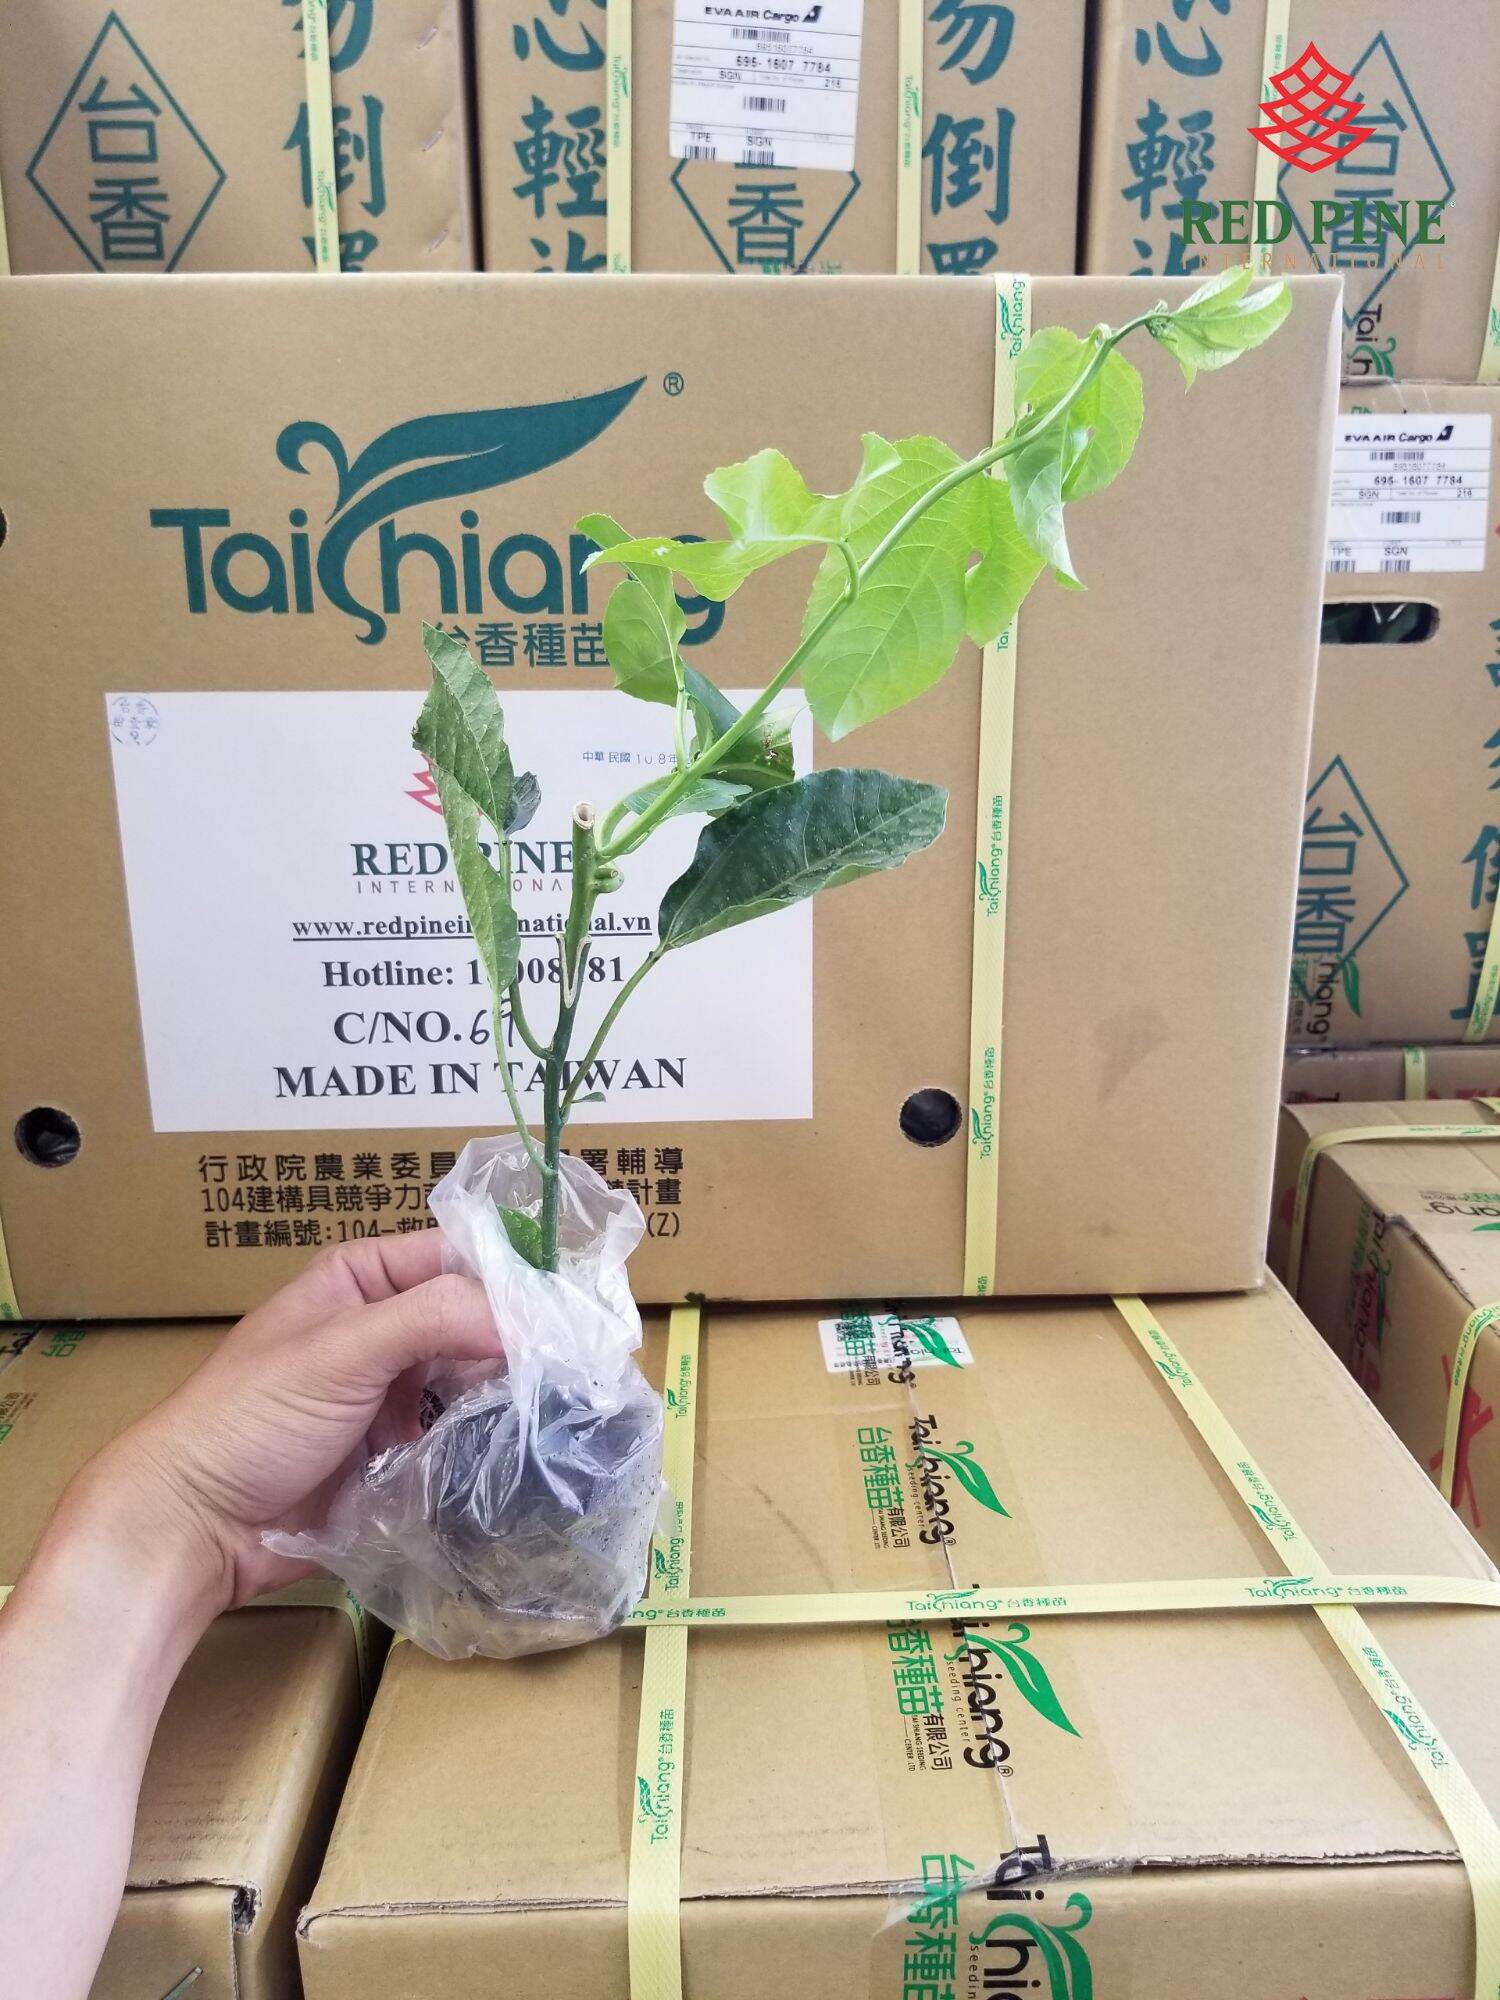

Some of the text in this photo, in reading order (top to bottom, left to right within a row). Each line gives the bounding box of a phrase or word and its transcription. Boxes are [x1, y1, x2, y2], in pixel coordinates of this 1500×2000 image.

[705, 7, 800, 23] EVA AIR Cargo
[79, 76, 171, 262] 台香
[1399, 431, 1434, 444] Cargo
[350, 842, 448, 876] RED
[1293, 806, 1364, 954] 台香
[323, 960, 454, 987] Hotline:
[273, 1057, 688, 1098] MADE IN TAIWAN
[648, 1211, 681, 1238] (Z)
[858, 1426, 905, 1510] 台香種苗
[888, 1507, 910, 1549] 有限公司
[946, 1661, 970, 1742] seeding center
[922, 1713, 952, 1770] 有限公司
